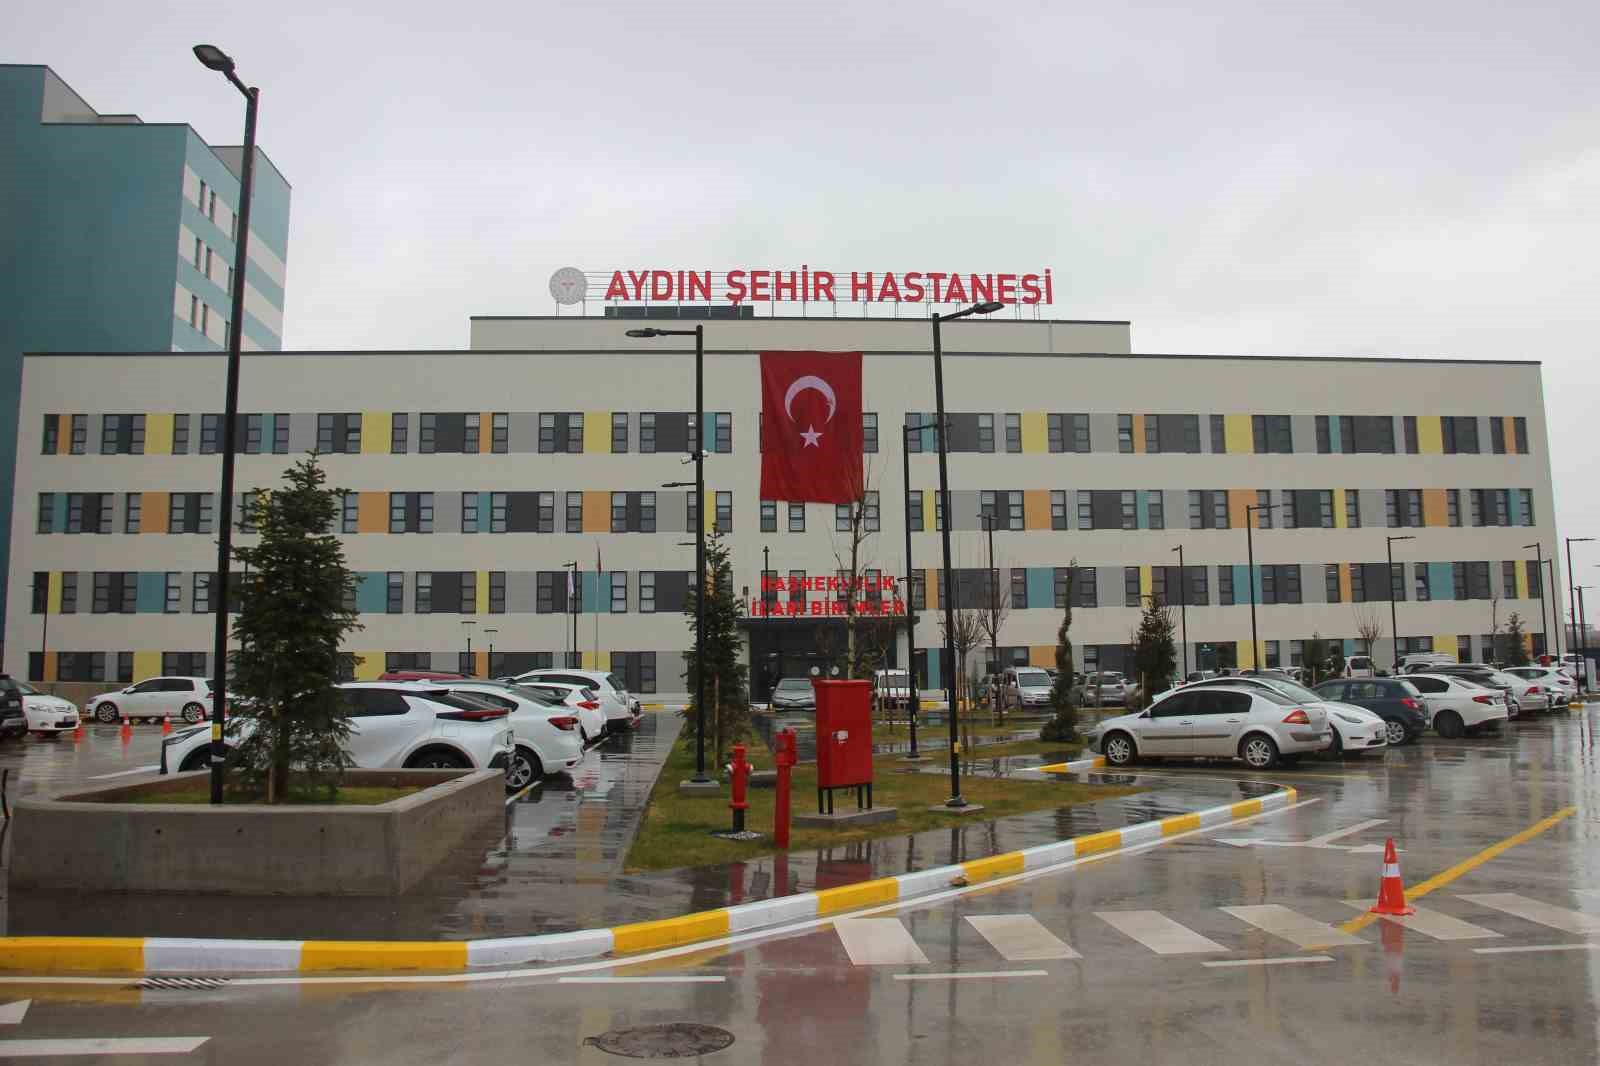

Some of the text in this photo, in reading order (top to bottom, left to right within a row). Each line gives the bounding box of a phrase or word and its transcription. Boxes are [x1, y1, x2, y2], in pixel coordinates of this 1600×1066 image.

[606, 265, 1053, 307] AYDIN ŞEHİR HASTANESİ
